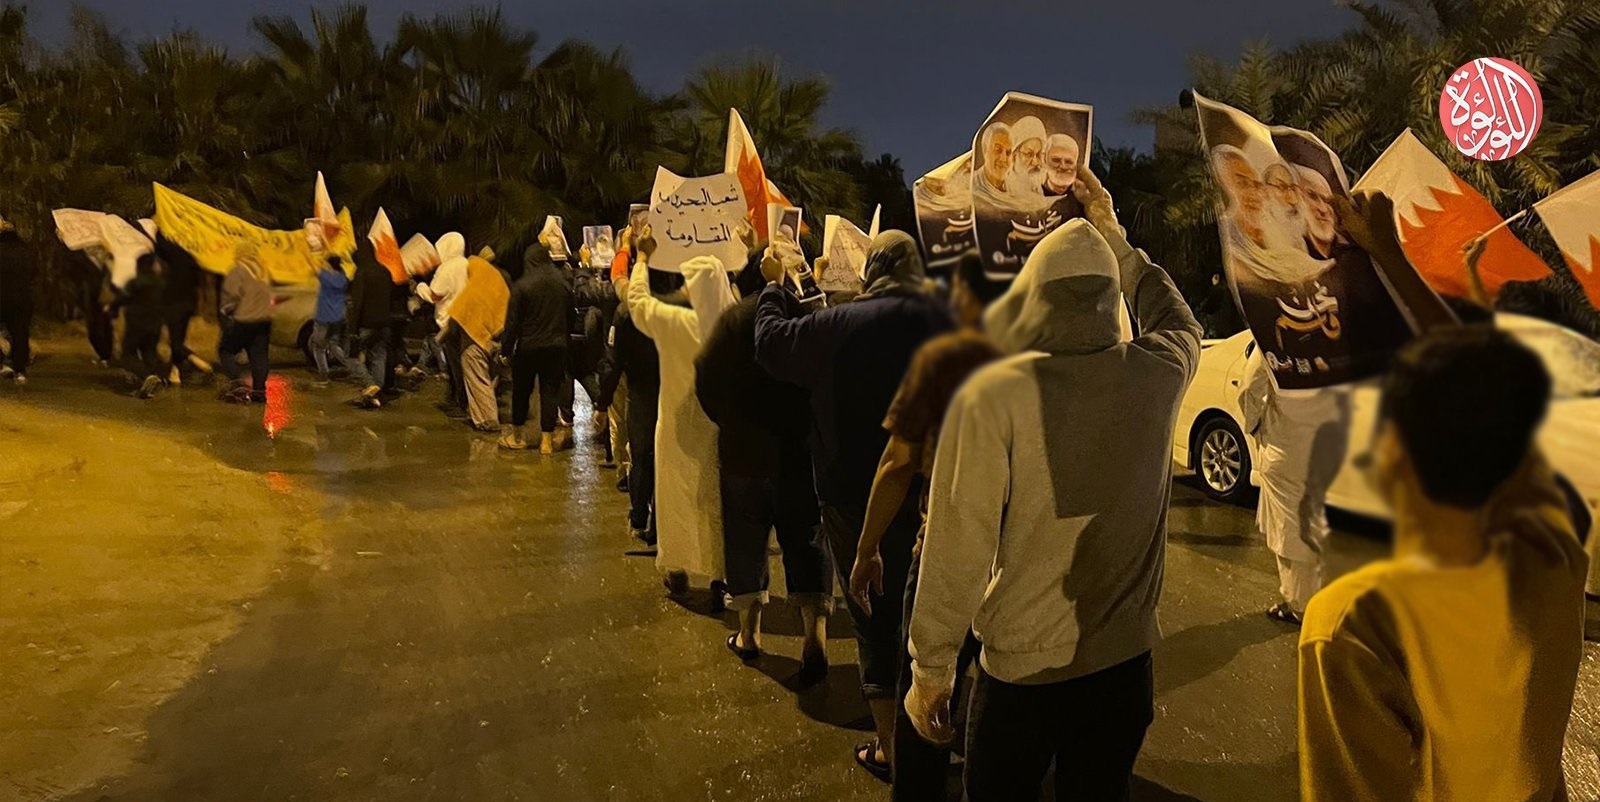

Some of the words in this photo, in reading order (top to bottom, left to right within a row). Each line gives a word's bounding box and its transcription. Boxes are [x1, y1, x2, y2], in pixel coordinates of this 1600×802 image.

[670, 186, 711, 216] البحرين
[710, 183, 739, 213] شعب
[665, 219, 732, 249] المقاومة
